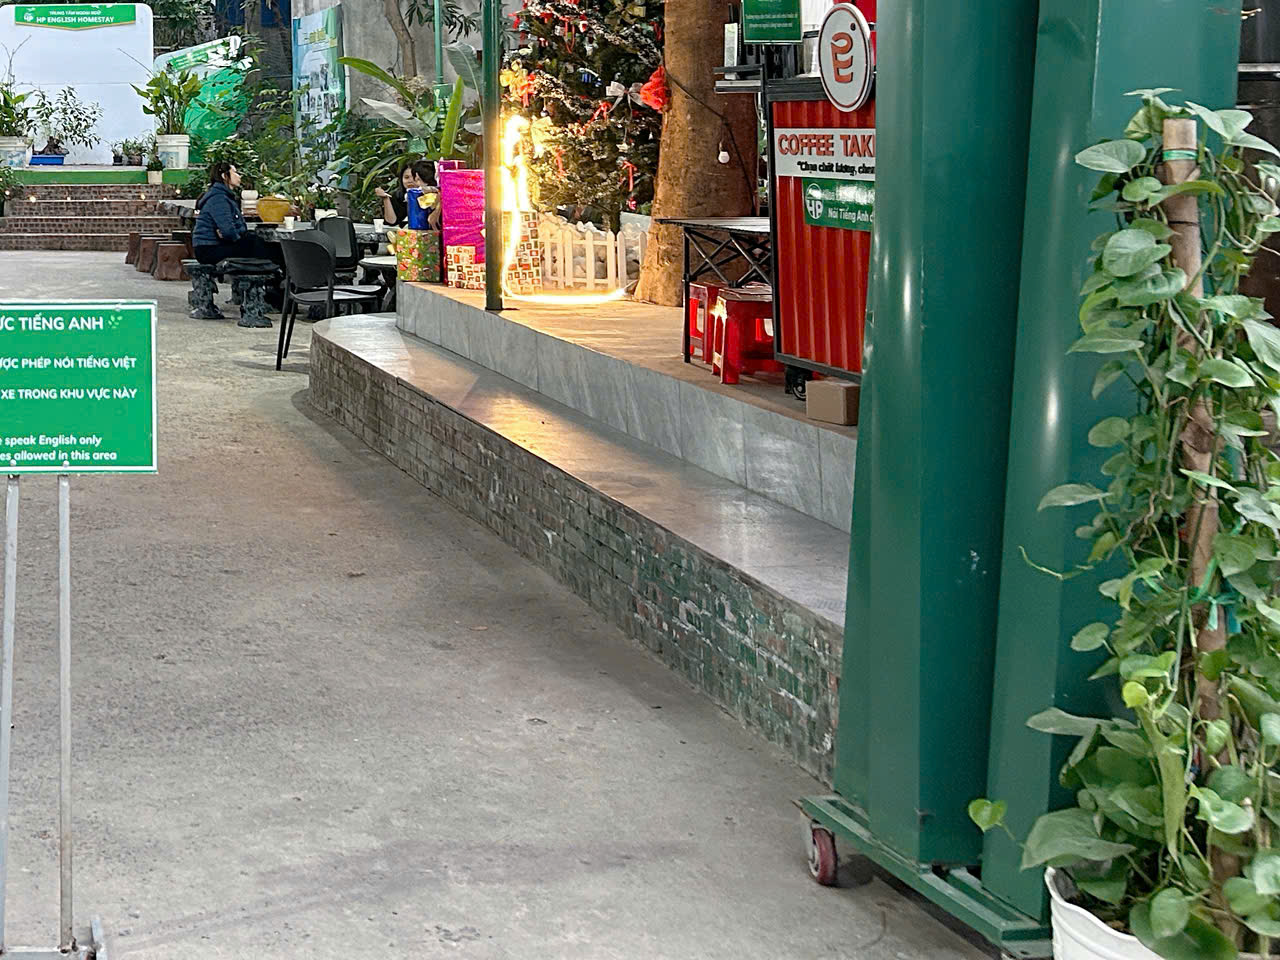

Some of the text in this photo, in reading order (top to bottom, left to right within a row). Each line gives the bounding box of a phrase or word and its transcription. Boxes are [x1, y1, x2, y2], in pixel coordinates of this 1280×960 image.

[778, 134, 835, 157] COFFEE
[856, 210, 870, 223] Anh
[18, 313, 65, 331] TIẾNG
[68, 316, 104, 331] ANH
[22, 356, 51, 369] PHÉP
[54, 356, 75, 369] NÓI
[76, 355, 110, 369] TIẾNG
[112, 356, 137, 370] VIỆT
[1, 389, 16, 400] XE
[18, 388, 58, 400] TRONG
[60, 388, 84, 399] KHU
[87, 387, 111, 401] VỰC
[113, 386, 138, 399] NÀY
[5, 434, 37, 448] speak
[38, 433, 76, 448] English
[79, 434, 103, 448] only
[14, 450, 57, 462] allowed
[59, 450, 68, 461] in
[70, 450, 90, 461] this
[92, 451, 118, 461] area
